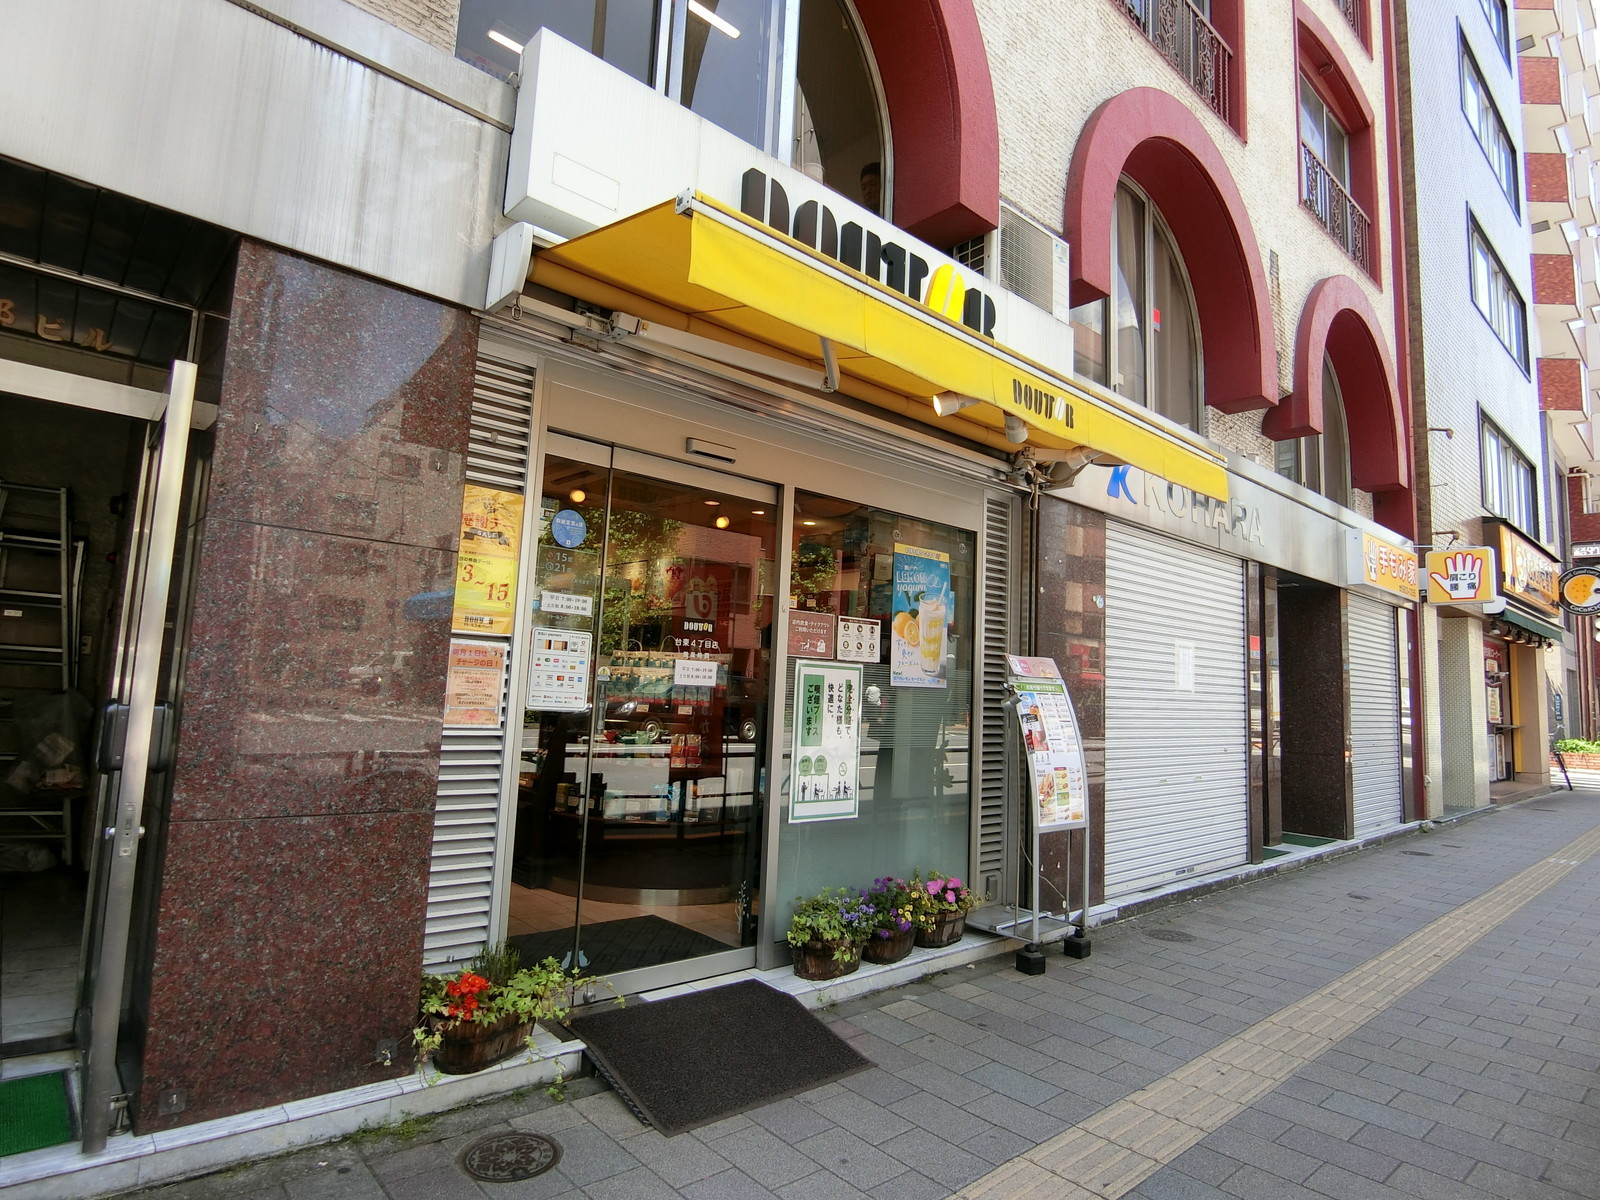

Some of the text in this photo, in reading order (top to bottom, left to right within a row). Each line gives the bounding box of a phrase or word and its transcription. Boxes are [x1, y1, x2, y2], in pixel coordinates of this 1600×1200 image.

[1013, 378, 1074, 429] DOUTOR
[462, 512, 514, 530] 感謝デー
[1144, 471, 1265, 547] KOHARA
[477, 530, 498, 538] SALE
[462, 564, 474, 582] 3
[487, 583, 509, 601] 15
[1379, 545, 1416, 586] 手もみ家
[1450, 572, 1477, 582] 肩こり
[675, 638, 719, 649] 台東4丁目店
[684, 621, 713, 632] DOUTOR
[806, 684, 814, 737] ございます
[812, 684, 821, 736] 喫煙ブース
